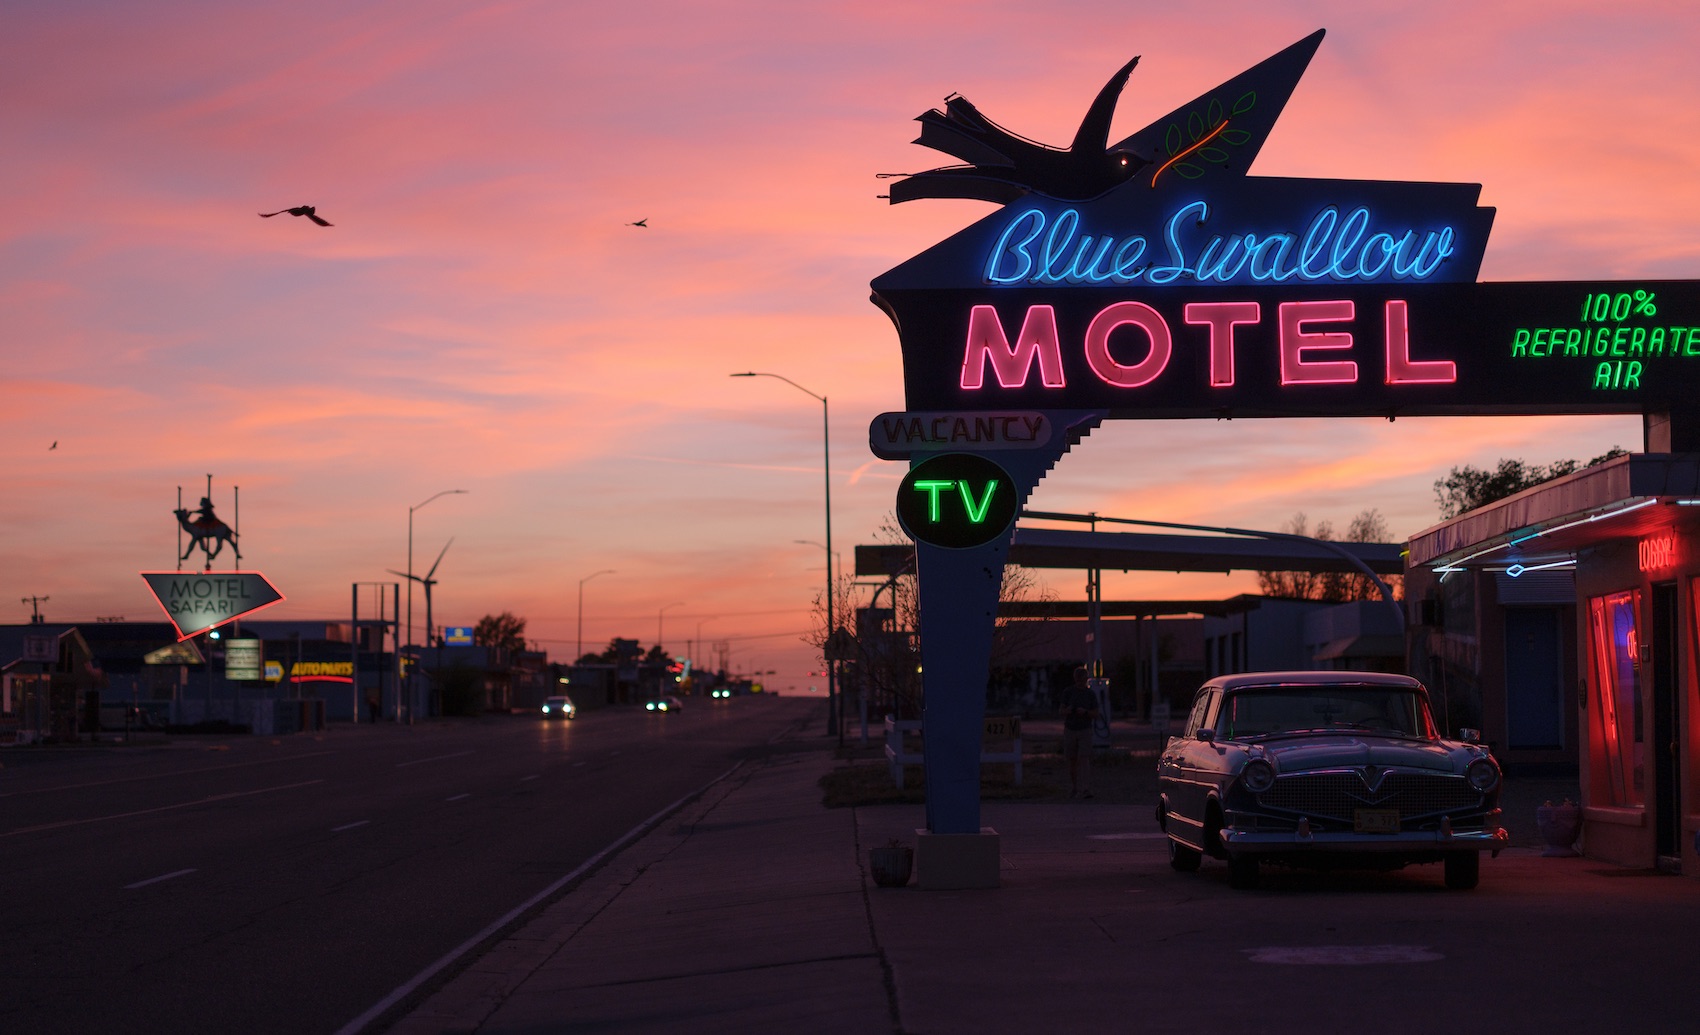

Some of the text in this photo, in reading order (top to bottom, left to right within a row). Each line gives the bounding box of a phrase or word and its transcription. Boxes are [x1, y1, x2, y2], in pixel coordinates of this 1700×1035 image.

[983, 199, 1456, 285] Blue Swallow
[1580, 289, 1658, 322] 100%
[960, 300, 1457, 390] MOTEL
[1510, 326, 1700, 358] REFRIGERATE
[1591, 360, 1643, 390] AIR
[882, 415, 1044, 443] VACANCY
[913, 479, 1000, 525] TV
[1638, 536, 1673, 571] LOBBY
[169, 579, 251, 599] MOTEL
[169, 600, 235, 614] SAFARI
[290, 661, 320, 676] AUTO
[320, 661, 354, 676] PARTS
